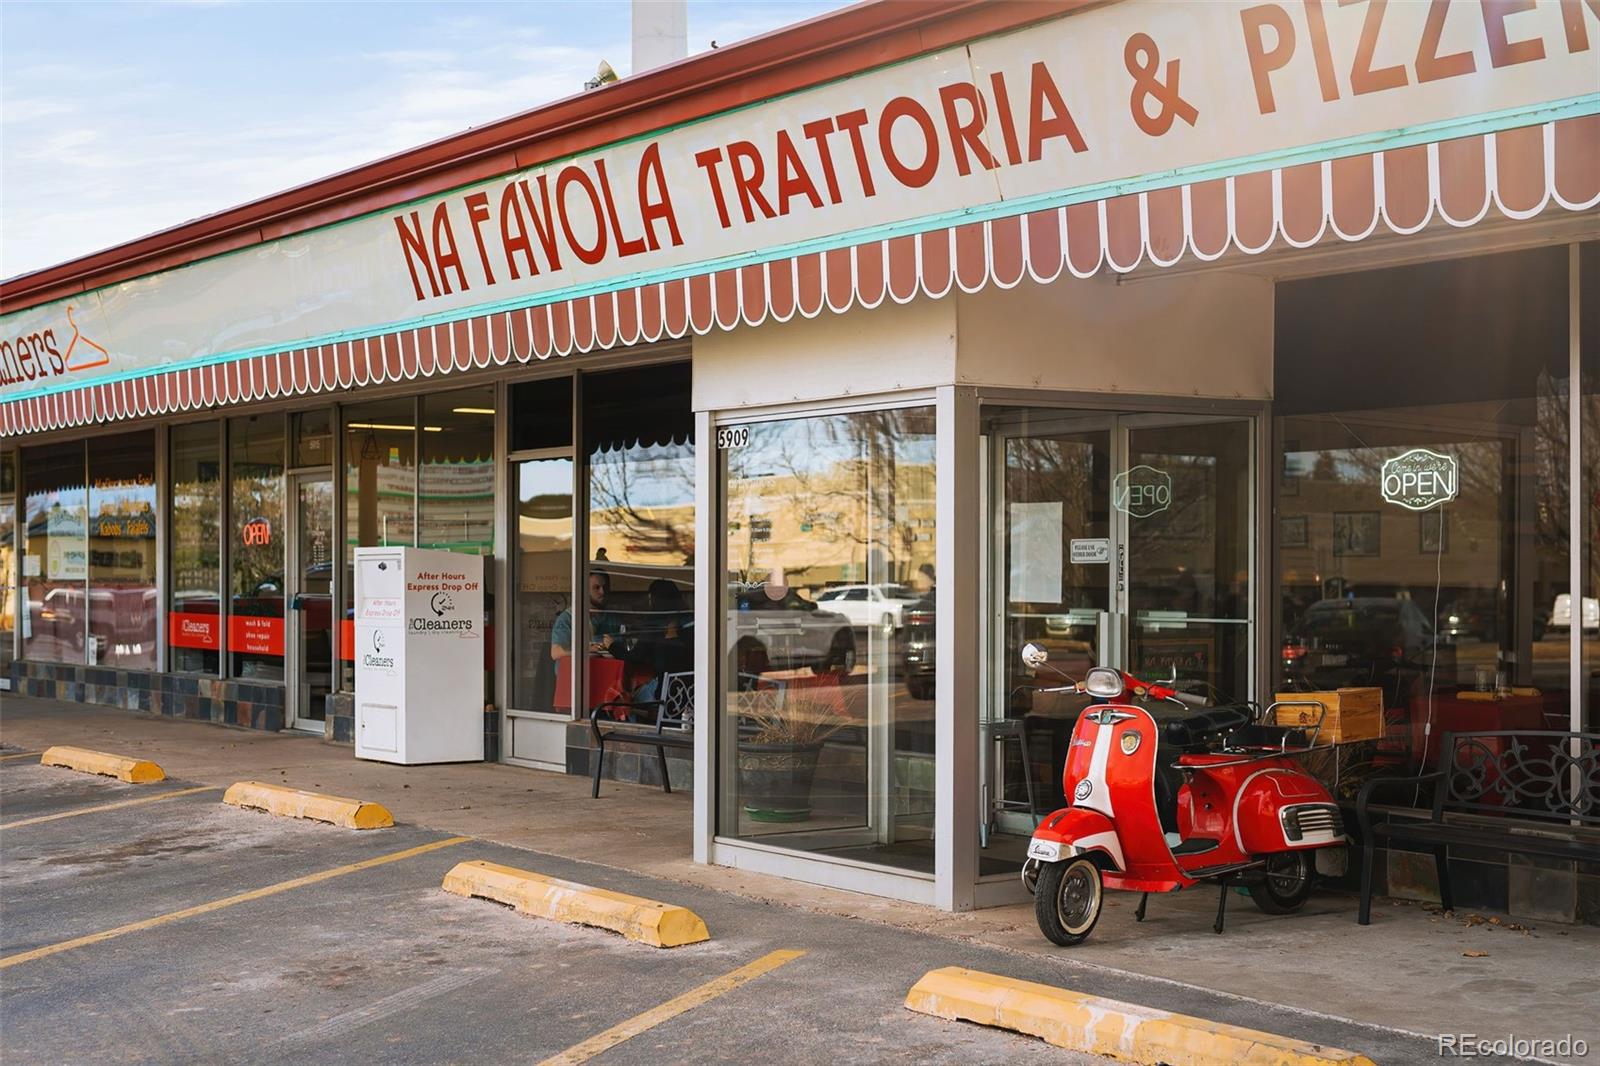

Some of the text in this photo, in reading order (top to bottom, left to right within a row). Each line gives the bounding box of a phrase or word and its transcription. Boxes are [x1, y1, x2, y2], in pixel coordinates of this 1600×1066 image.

[393, 201, 470, 301] NA
[463, 141, 684, 286] FAVOLA
[695, 60, 1089, 229] TRATTORIA
[1123, 32, 1200, 137] &
[718, 428, 749, 448] 5909
[1384, 470, 1452, 496] OPEN
[243, 523, 271, 545] OPEN
[417, 572, 466, 580] After Hours
[407, 582, 479, 592] Express Drop Off
[413, 618, 473, 631] Cleaners
[364, 654, 394, 668] Cleaners
